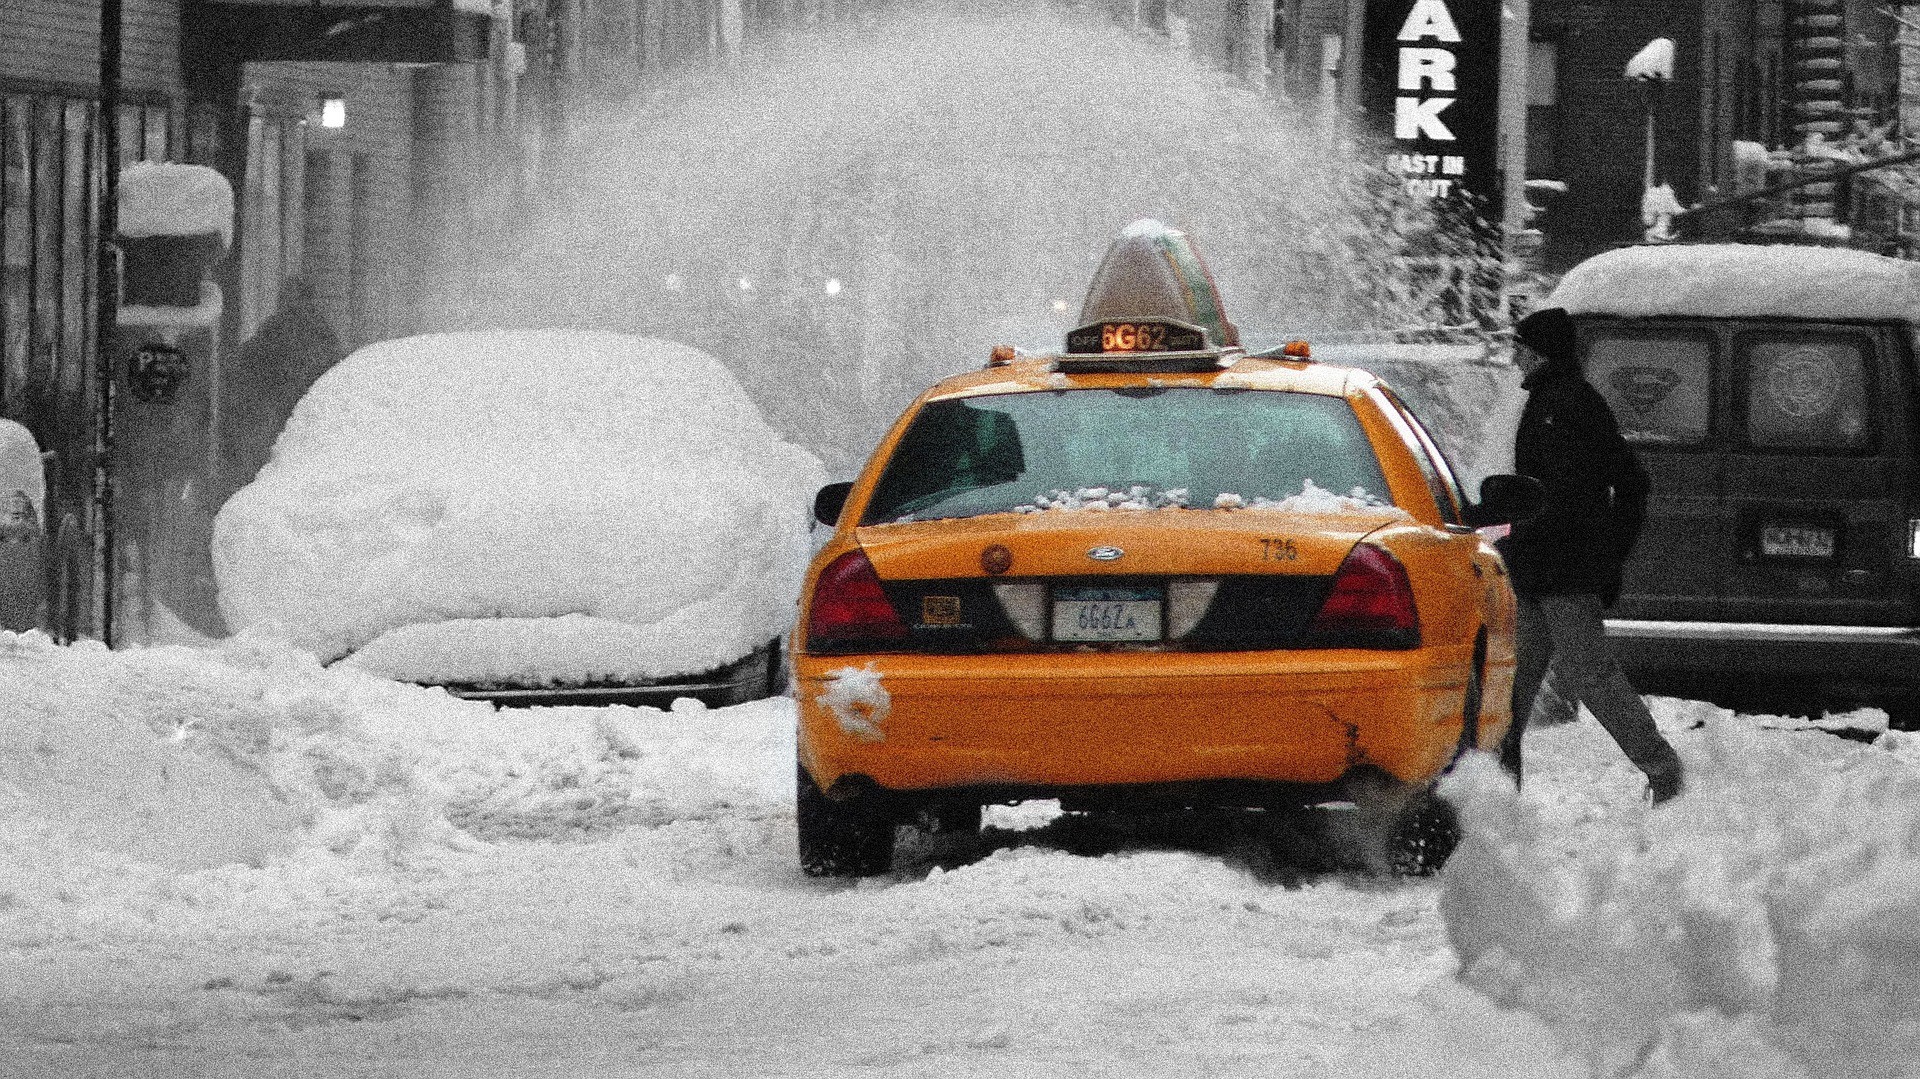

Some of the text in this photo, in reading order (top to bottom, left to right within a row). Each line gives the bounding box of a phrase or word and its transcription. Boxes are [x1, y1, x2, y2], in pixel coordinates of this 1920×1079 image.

[1396, 0, 1462, 140] ARK
[1442, 155, 1465, 175] IN
[1406, 179, 1452, 199] OUT
[1102, 323, 1168, 350] 6G62
[1259, 538, 1298, 561] 736
